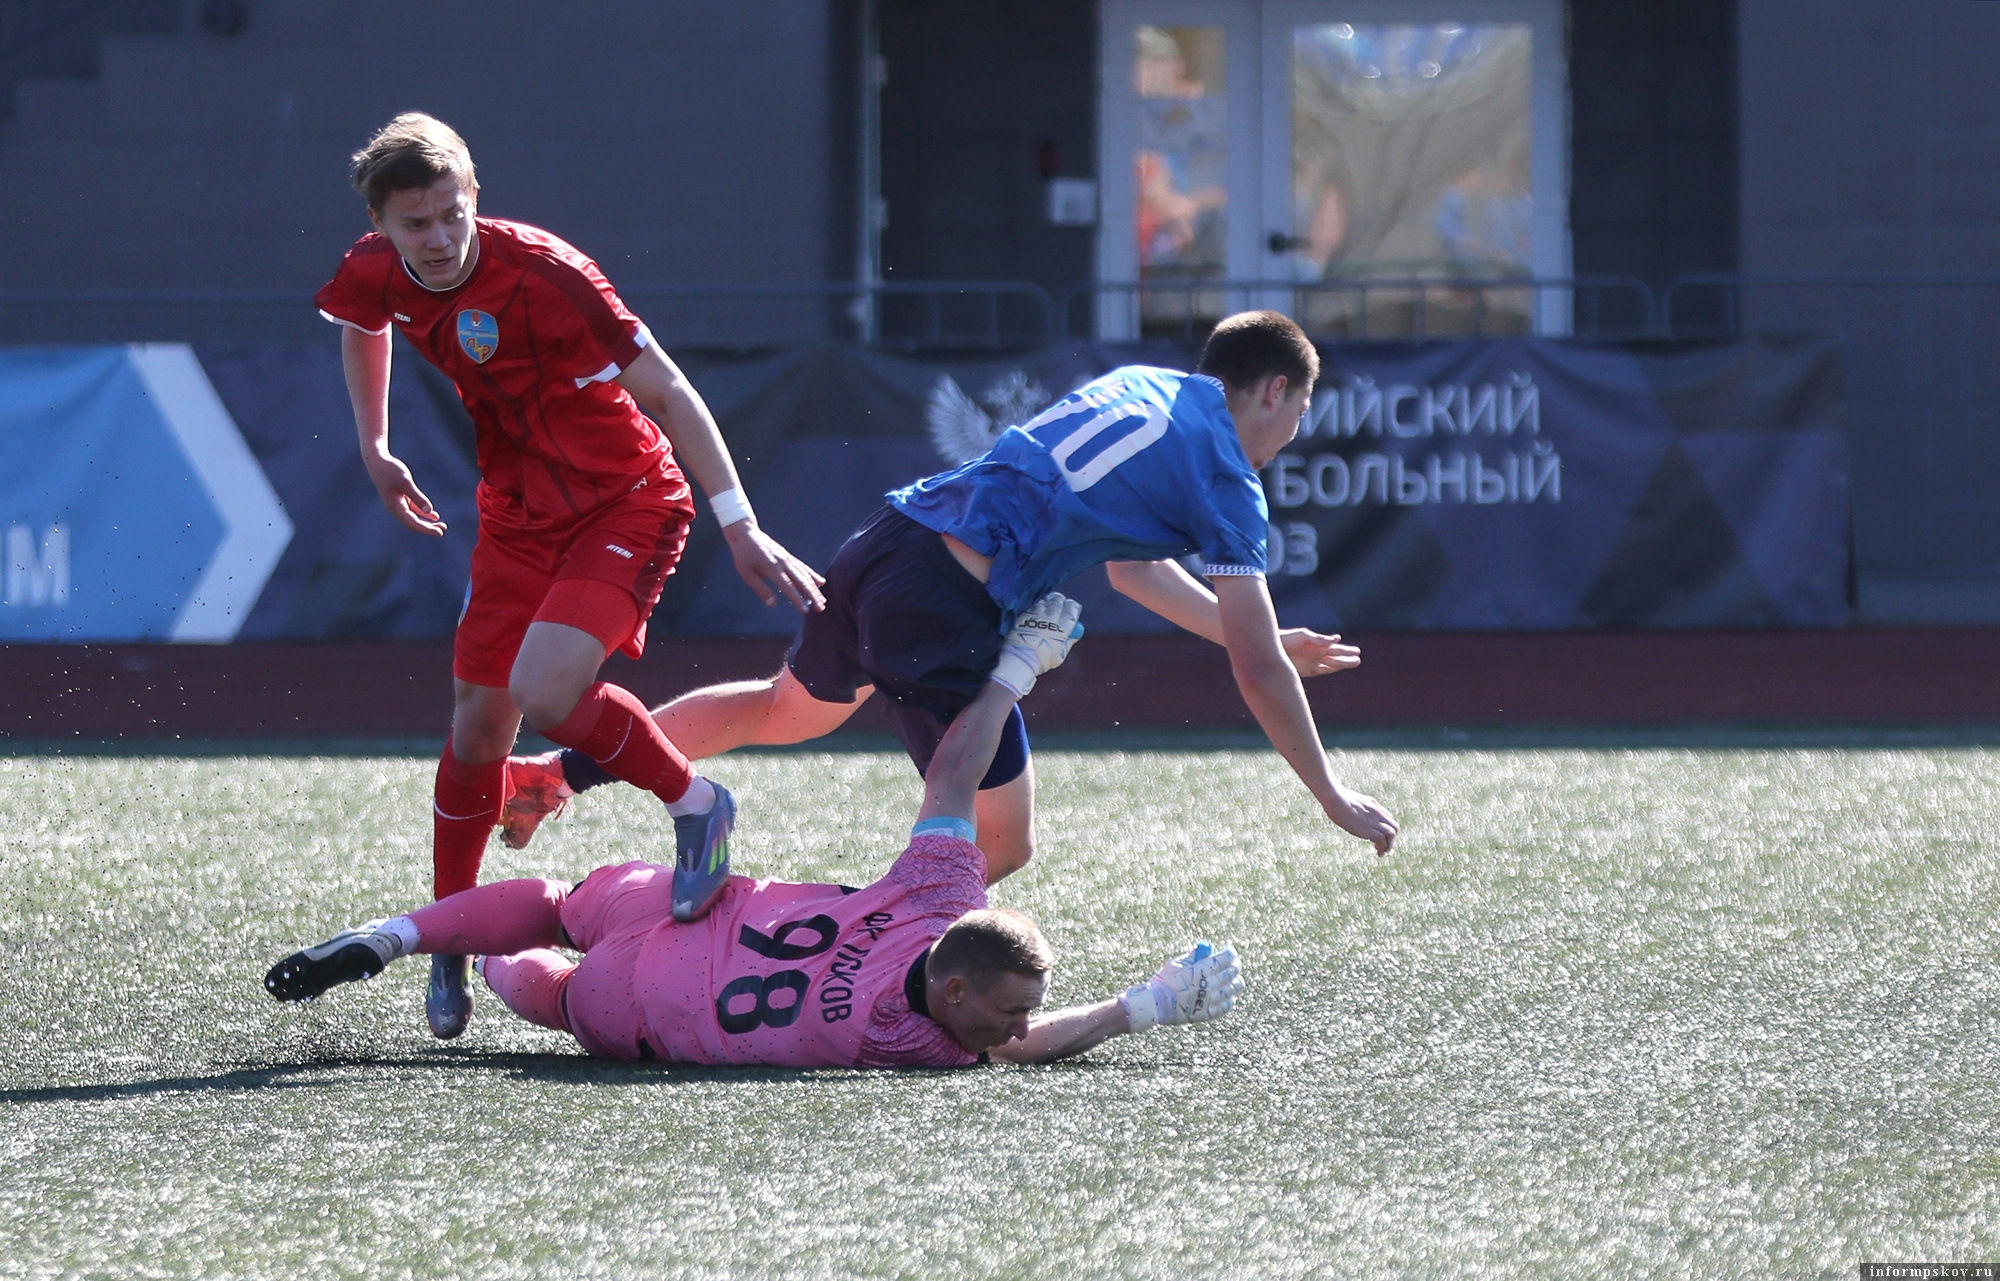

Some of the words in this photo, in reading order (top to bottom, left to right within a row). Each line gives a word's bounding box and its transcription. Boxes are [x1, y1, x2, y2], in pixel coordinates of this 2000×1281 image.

[1301, 372, 1541, 437] ИЙСКИЙ
[1266, 439, 1562, 507] БОЛЬНЫЙ
[1018, 617, 1065, 634] JÖGEL
[716, 913, 841, 1035] 98
